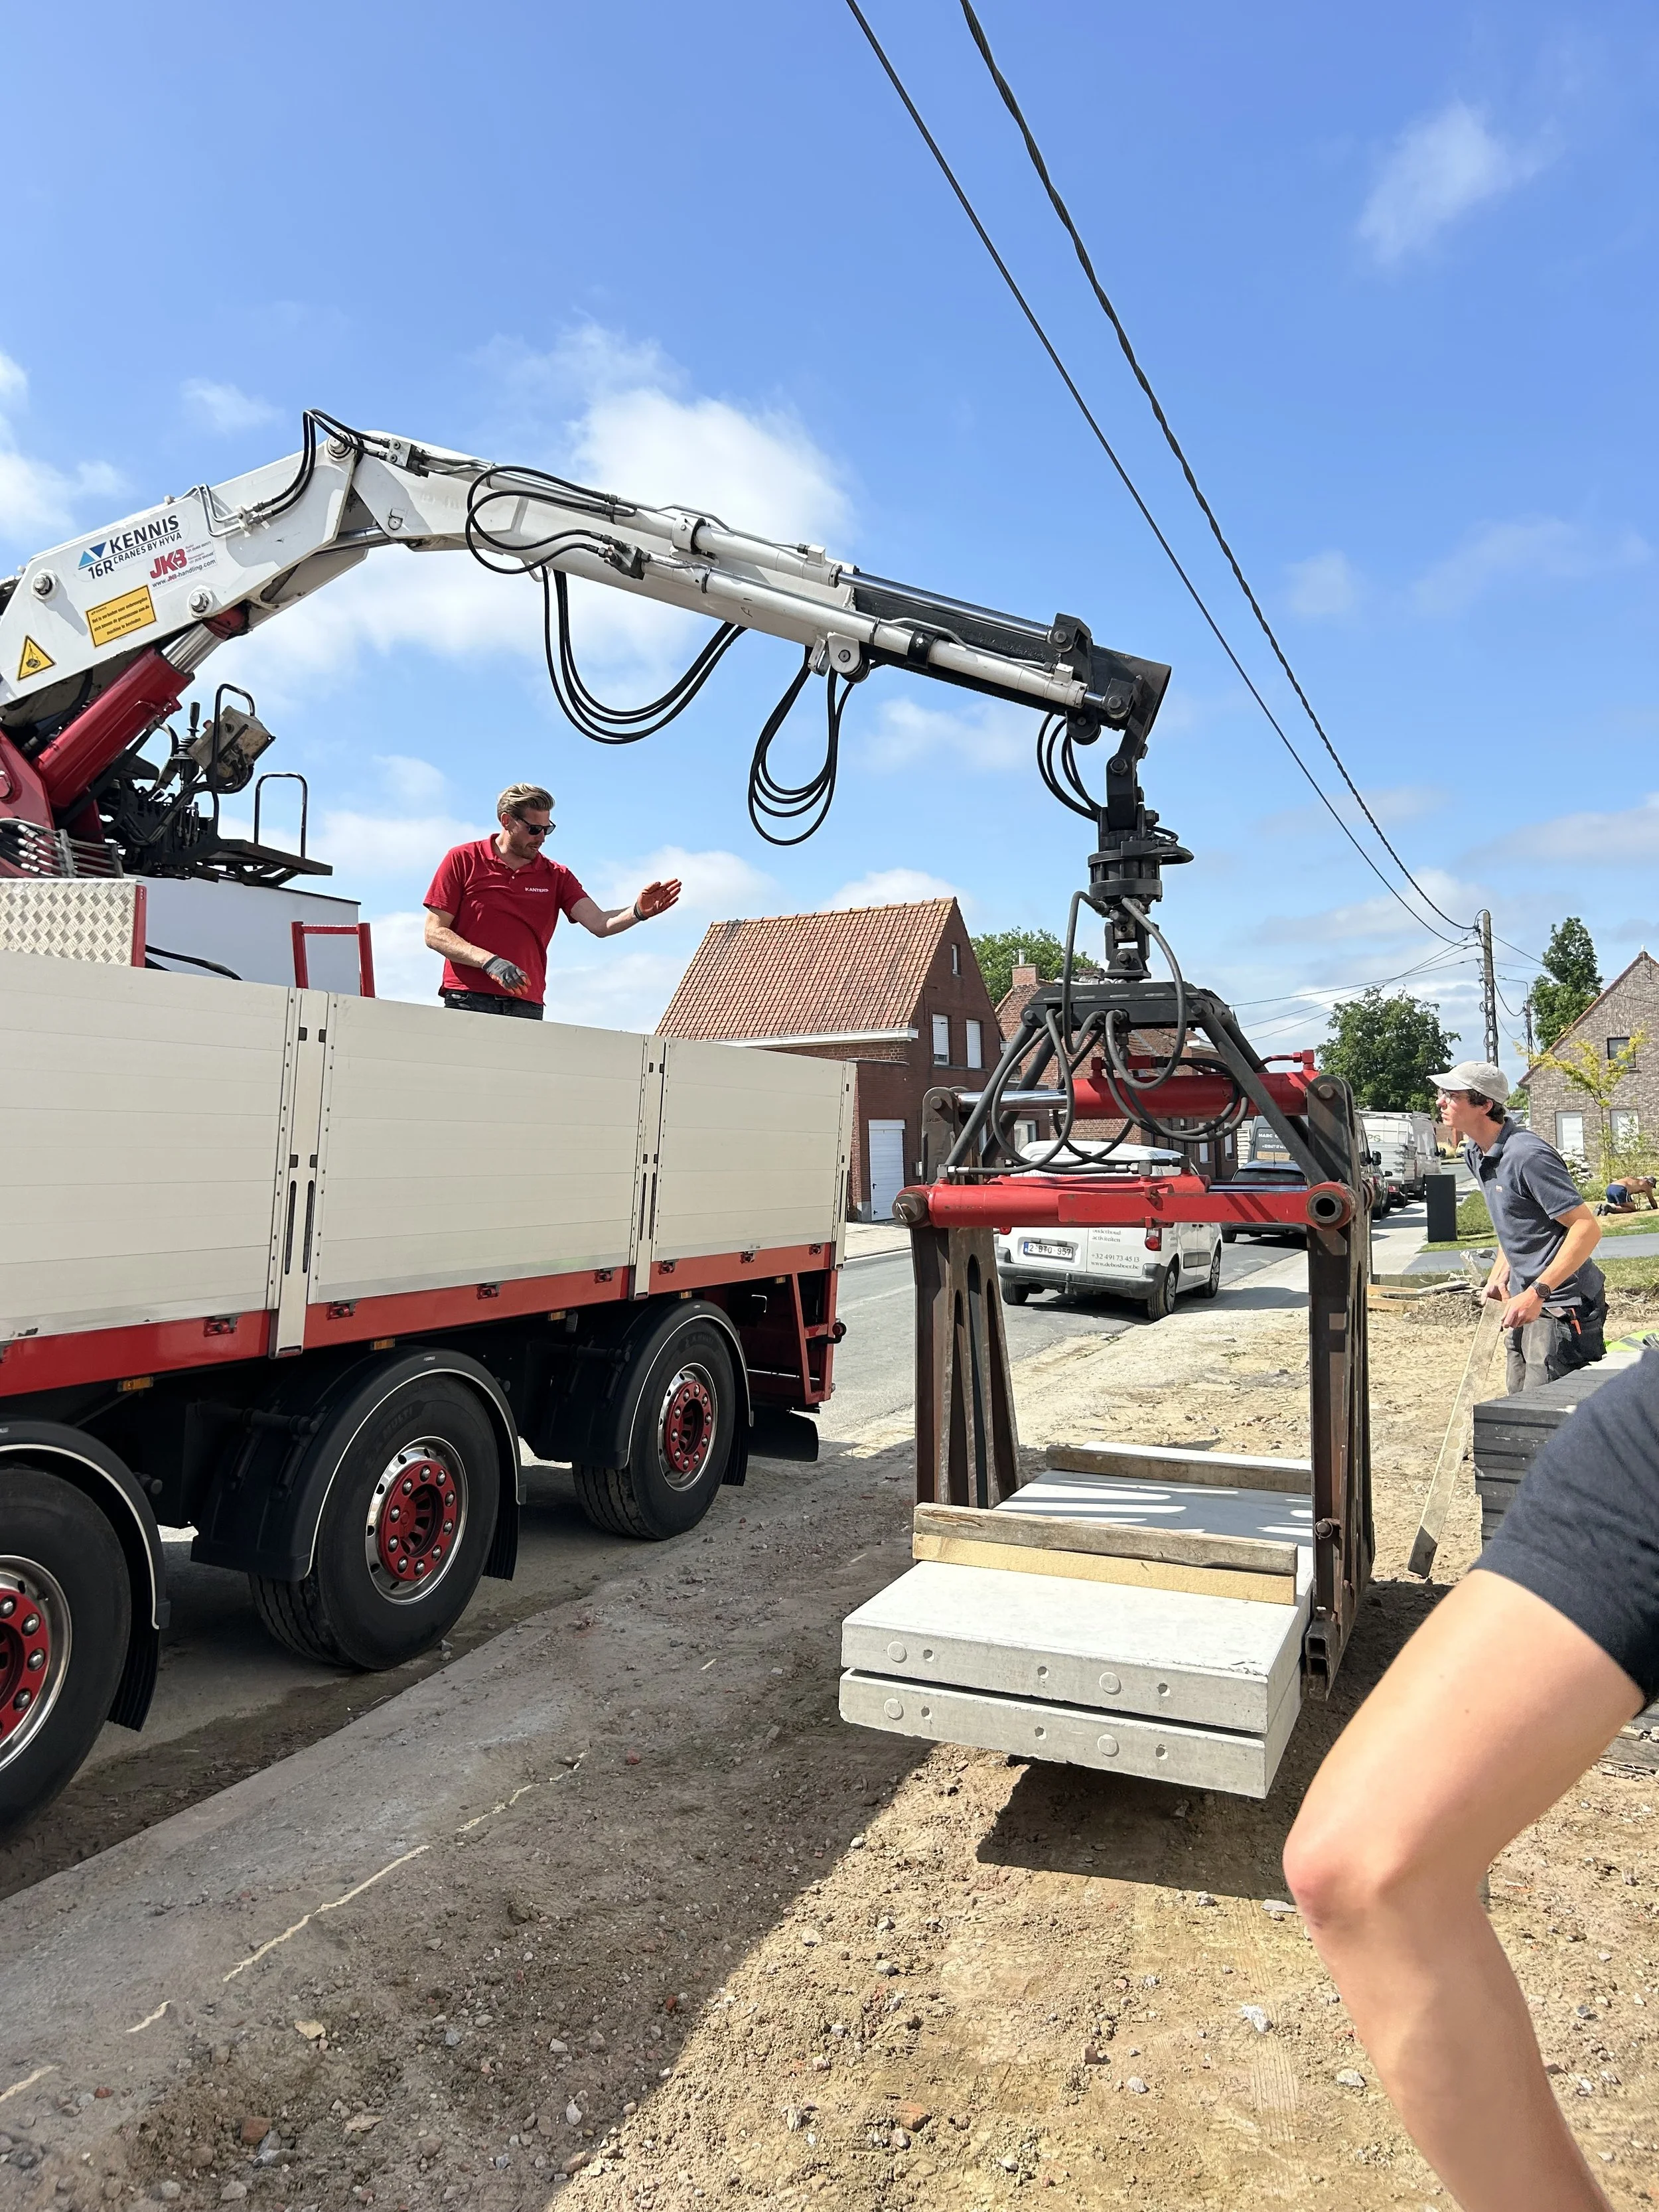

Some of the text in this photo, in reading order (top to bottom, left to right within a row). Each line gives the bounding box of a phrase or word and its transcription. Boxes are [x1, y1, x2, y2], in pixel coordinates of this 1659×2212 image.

[109, 515, 179, 553] KENNIS
[114, 546, 146, 564] CRANES
[148, 541, 157, 552] BY
[159, 532, 182, 547] HYVA
[88, 559, 115, 579] 16R
[149, 549, 188, 579] JKB
